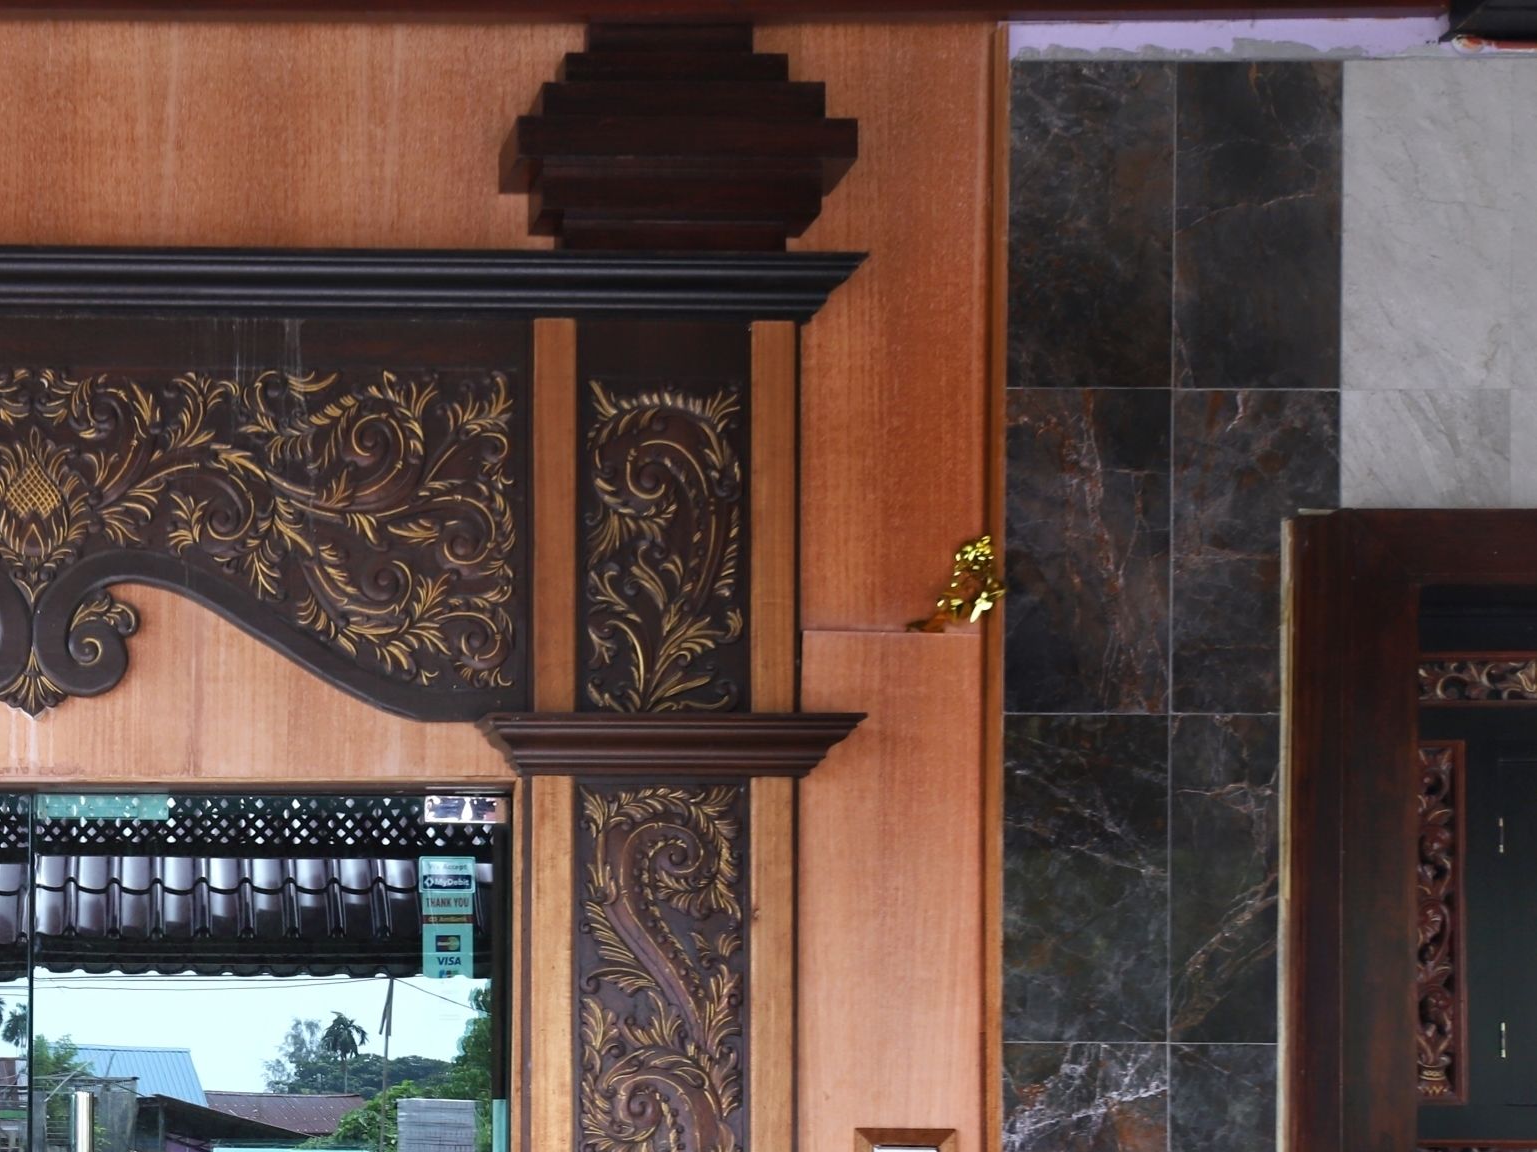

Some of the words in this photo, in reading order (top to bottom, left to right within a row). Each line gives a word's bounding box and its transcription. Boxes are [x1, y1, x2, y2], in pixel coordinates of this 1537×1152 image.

[443, 863, 467, 871] Accept
[434, 878, 470, 888] MyDebit
[426, 898, 452, 908] THANK
[454, 898, 470, 908] YOU
[437, 957, 462, 966] VISA
